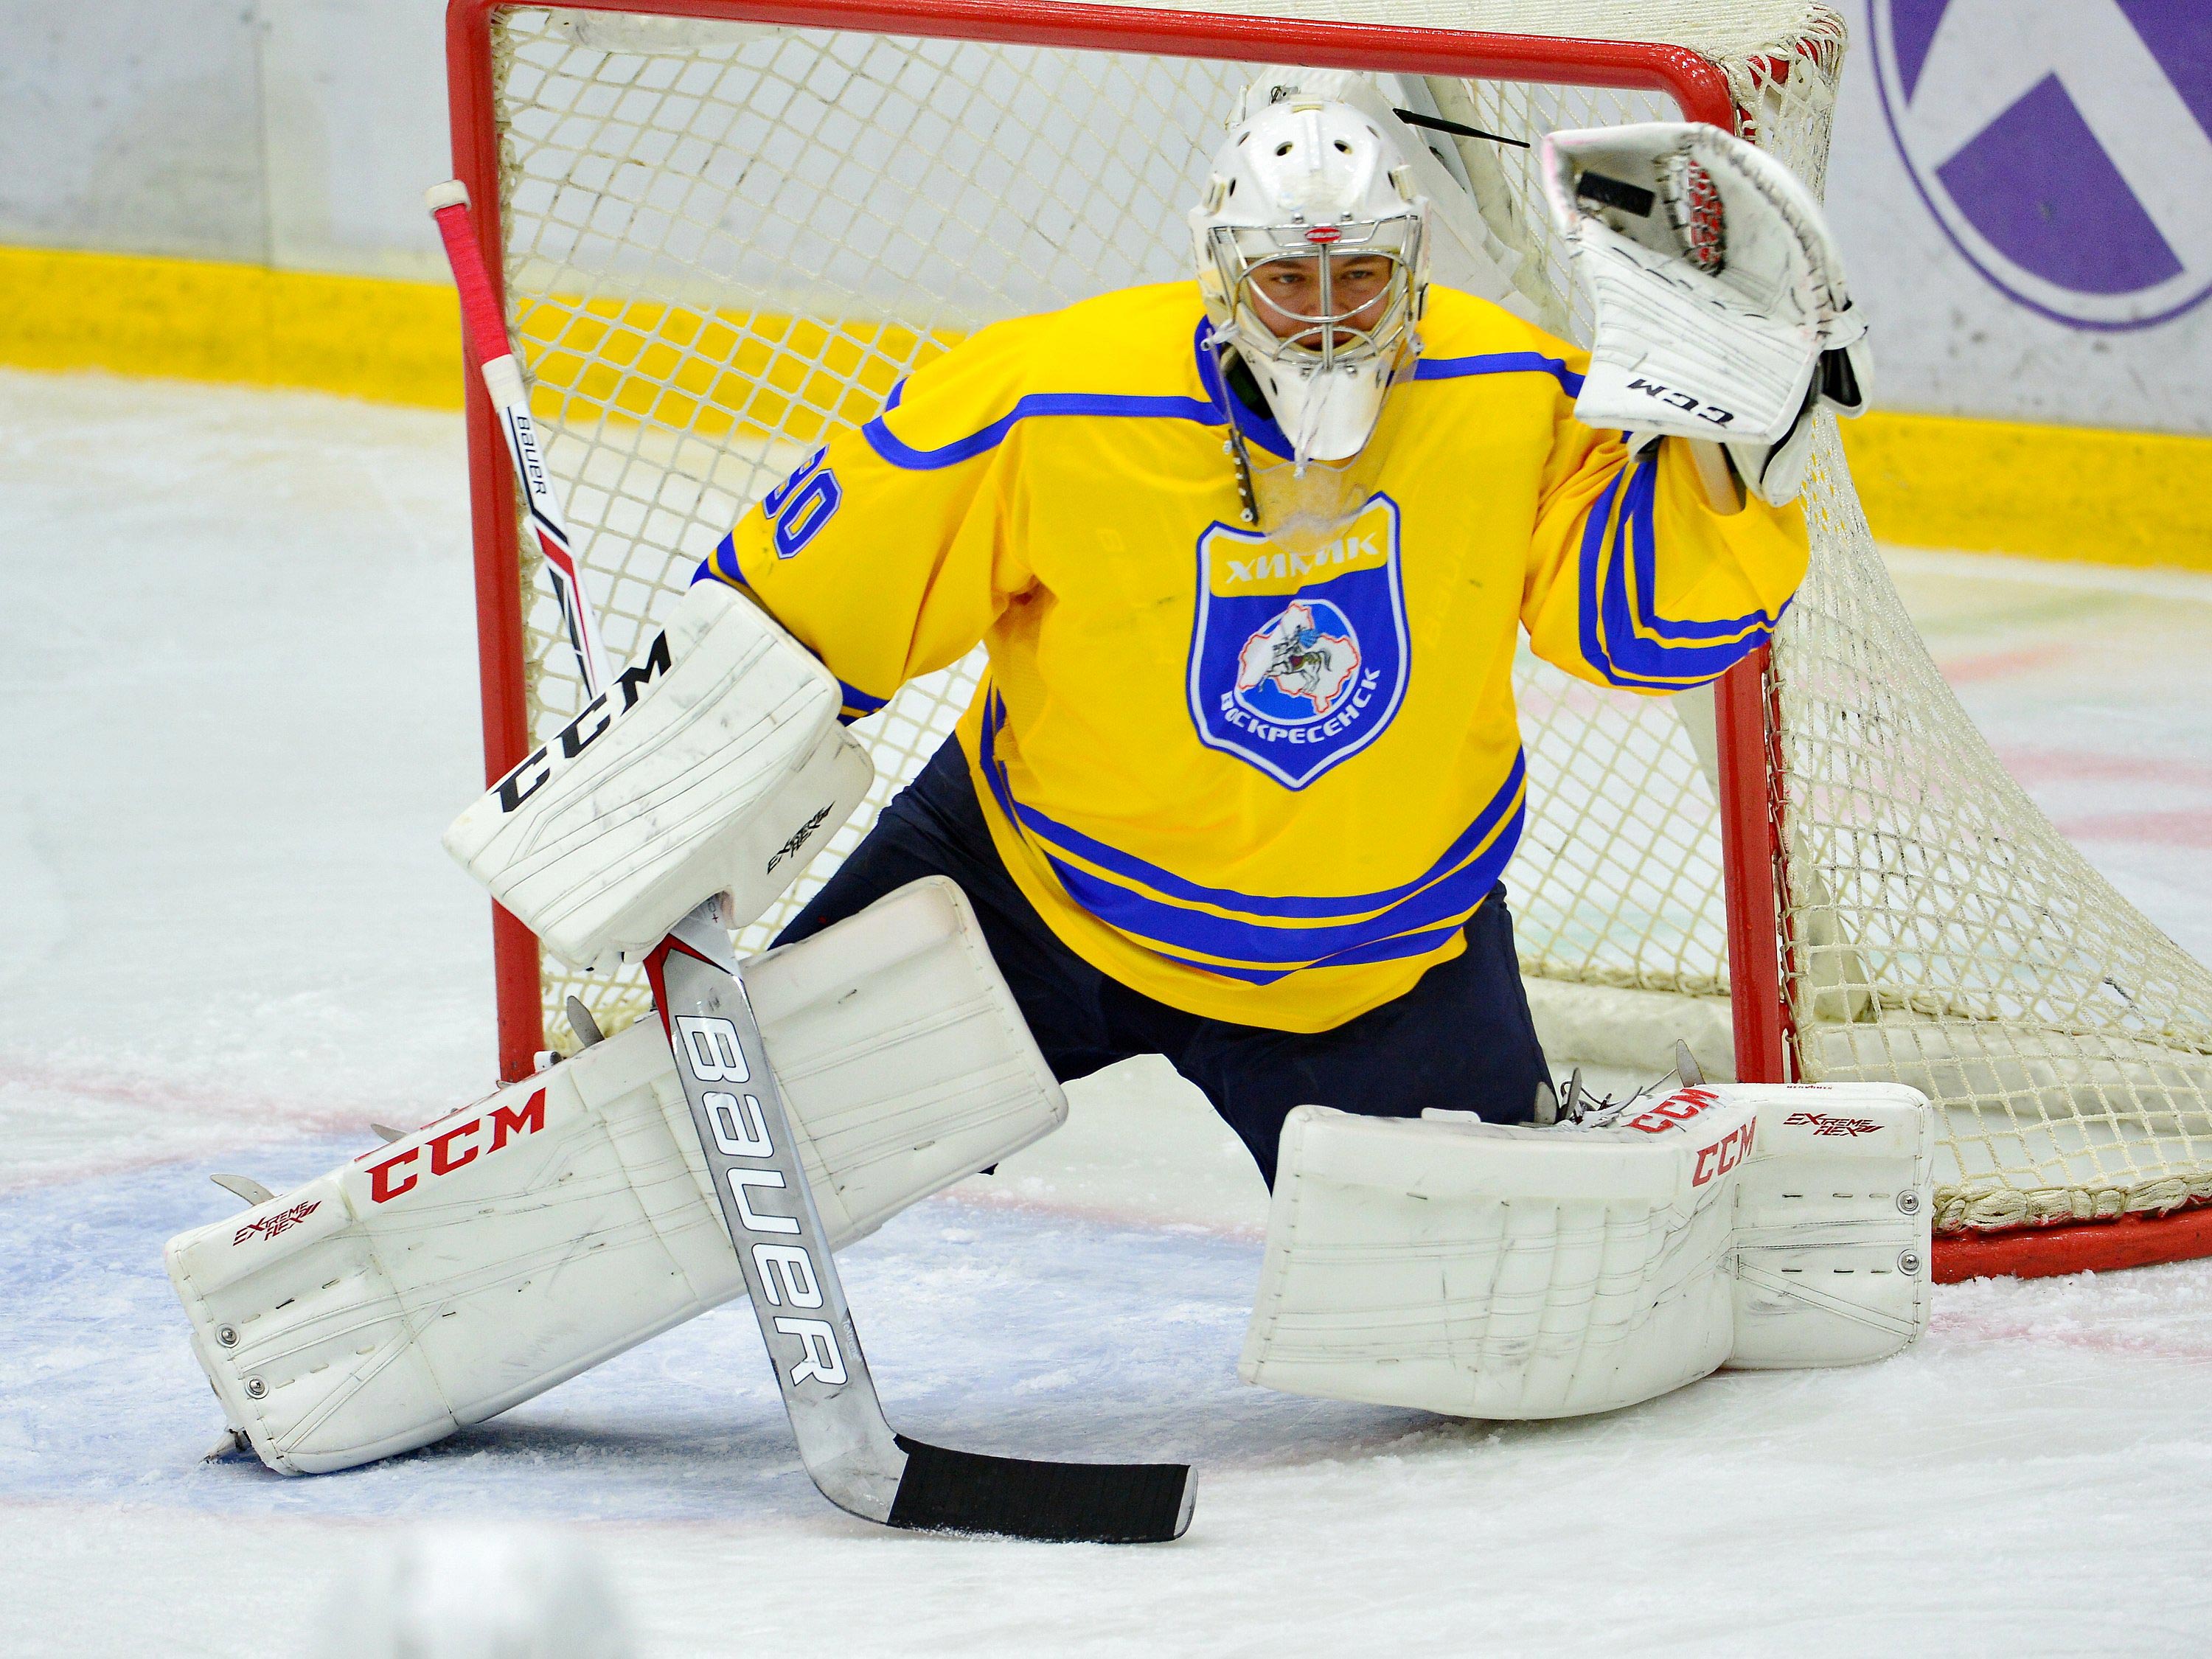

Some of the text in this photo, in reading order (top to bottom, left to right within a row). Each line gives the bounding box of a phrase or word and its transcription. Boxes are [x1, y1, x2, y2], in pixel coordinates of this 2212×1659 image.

[1627, 379, 1734, 428] CCM
[1226, 532, 1380, 584] ХИМИК
[490, 629, 672, 813] CCM
[1621, 1088, 1719, 1133] CCM
[1783, 1113, 1874, 1127] EXTREME
[1813, 1125, 1885, 1137] FLEX
[364, 1087, 546, 1203] CCM
[1691, 1115, 1757, 1187] CCM
[232, 1200, 308, 1246] EXTREME
[264, 1200, 322, 1241] FLEX
